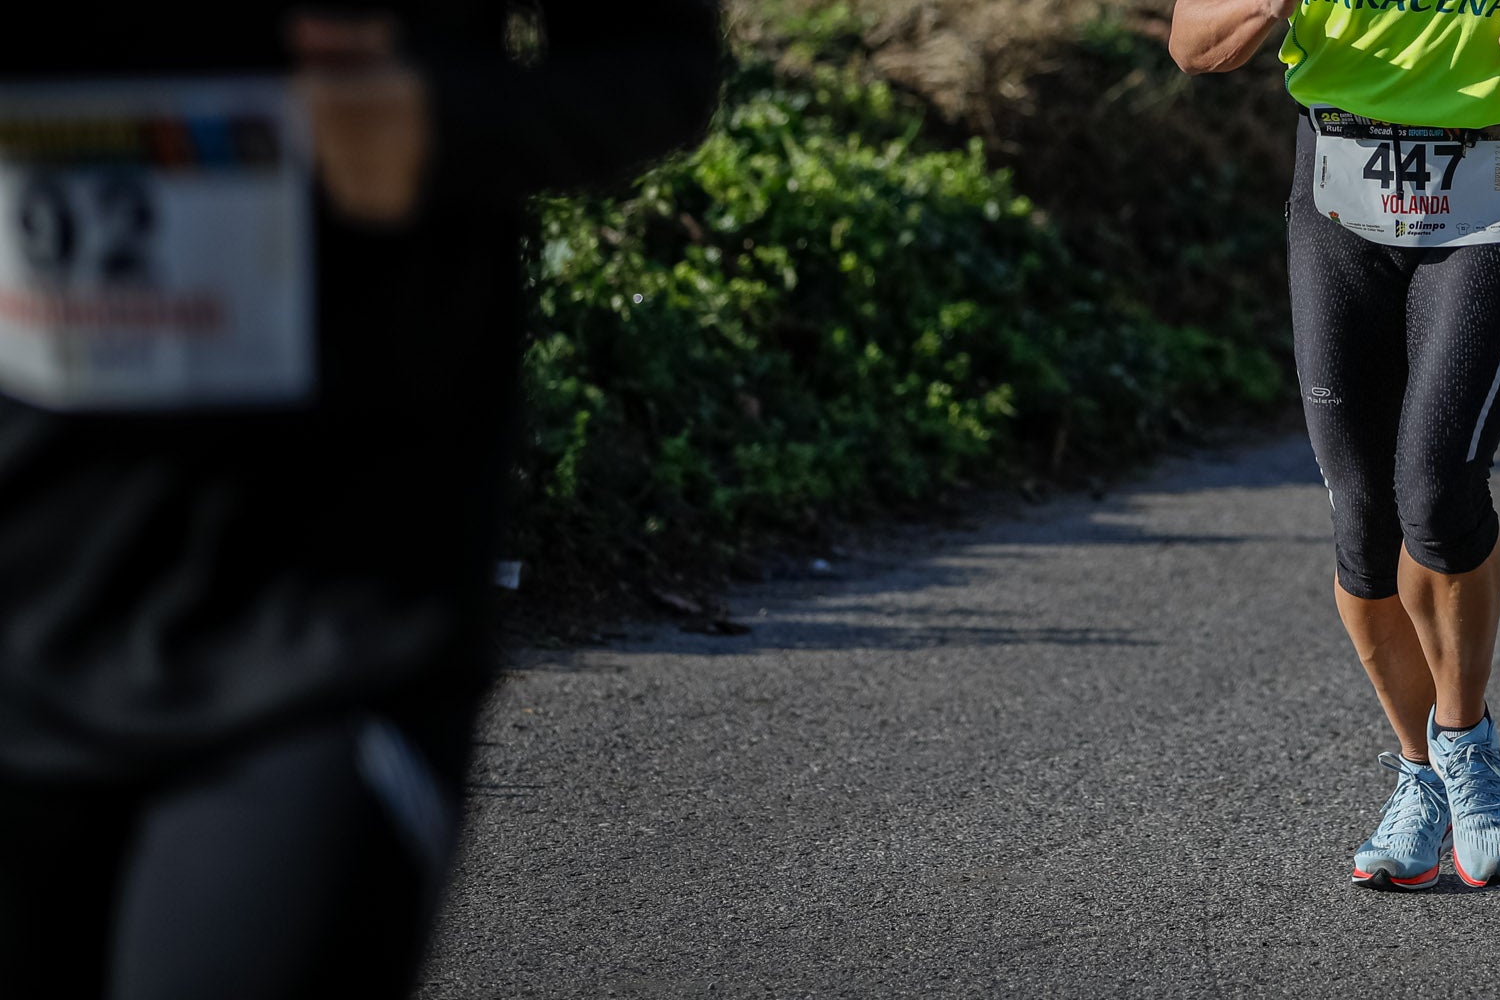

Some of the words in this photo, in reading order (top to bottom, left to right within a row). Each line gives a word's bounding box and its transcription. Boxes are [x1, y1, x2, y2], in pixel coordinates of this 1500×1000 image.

[1321, 112, 1340, 122] 26
[1363, 142, 1464, 191] 447
[1381, 194, 1450, 215] YOLANDA
[1409, 220, 1446, 232] olimpo
